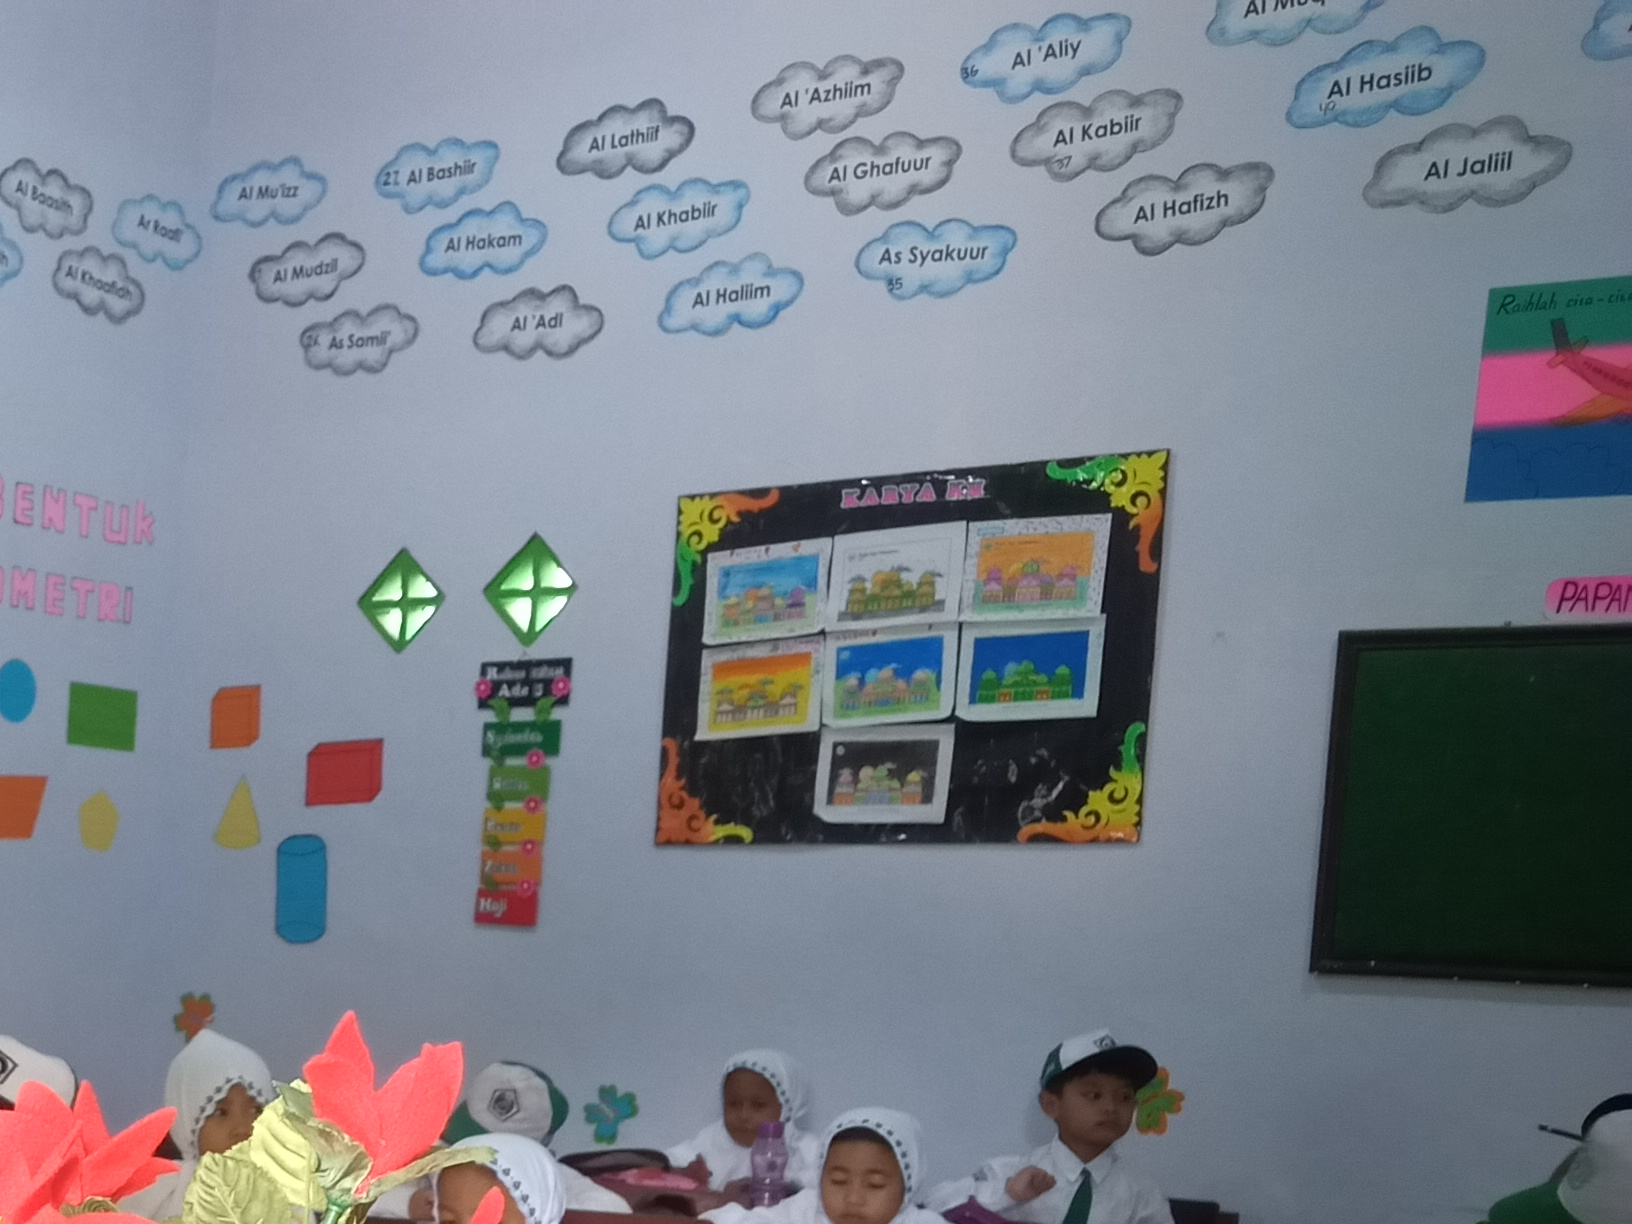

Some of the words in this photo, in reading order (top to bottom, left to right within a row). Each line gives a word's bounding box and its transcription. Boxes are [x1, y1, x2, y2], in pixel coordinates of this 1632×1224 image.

[1011, 49, 1031, 70] Al
[1326, 77, 1351, 100] Al
[1359, 62, 1433, 94] Hasiib
[780, 90, 799, 110] Al
[588, 134, 606, 154] Al
[610, 124, 660, 150] Lathiif
[1053, 127, 1073, 148] Al
[1080, 114, 1142, 142] Kabiir
[407, 170, 422, 187] Al
[427, 159, 477, 183] Bashiir
[827, 165, 847, 184] Al
[853, 156, 932, 180] Ghafuur
[1423, 159, 1449, 181] Al
[1456, 151, 1513, 177] Jaliil
[15, 179, 29, 197] Al
[238, 186, 253, 201] Al
[634, 213, 651, 232] Al
[656, 201, 718, 227] Khabiir
[1133, 203, 1155, 224] Al
[1163, 190, 1229, 219] Hafizh
[445, 237, 461, 253] Al
[465, 233, 522, 252] Hakam
[878, 248, 902, 266] As
[908, 244, 988, 267] Syakuur
[65, 265, 79, 280] Al
[272, 268, 287, 285] Al
[692, 290, 710, 309] Al
[715, 283, 771, 306] Haliim
[510, 315, 528, 333] Al
[328, 335, 344, 350] As
